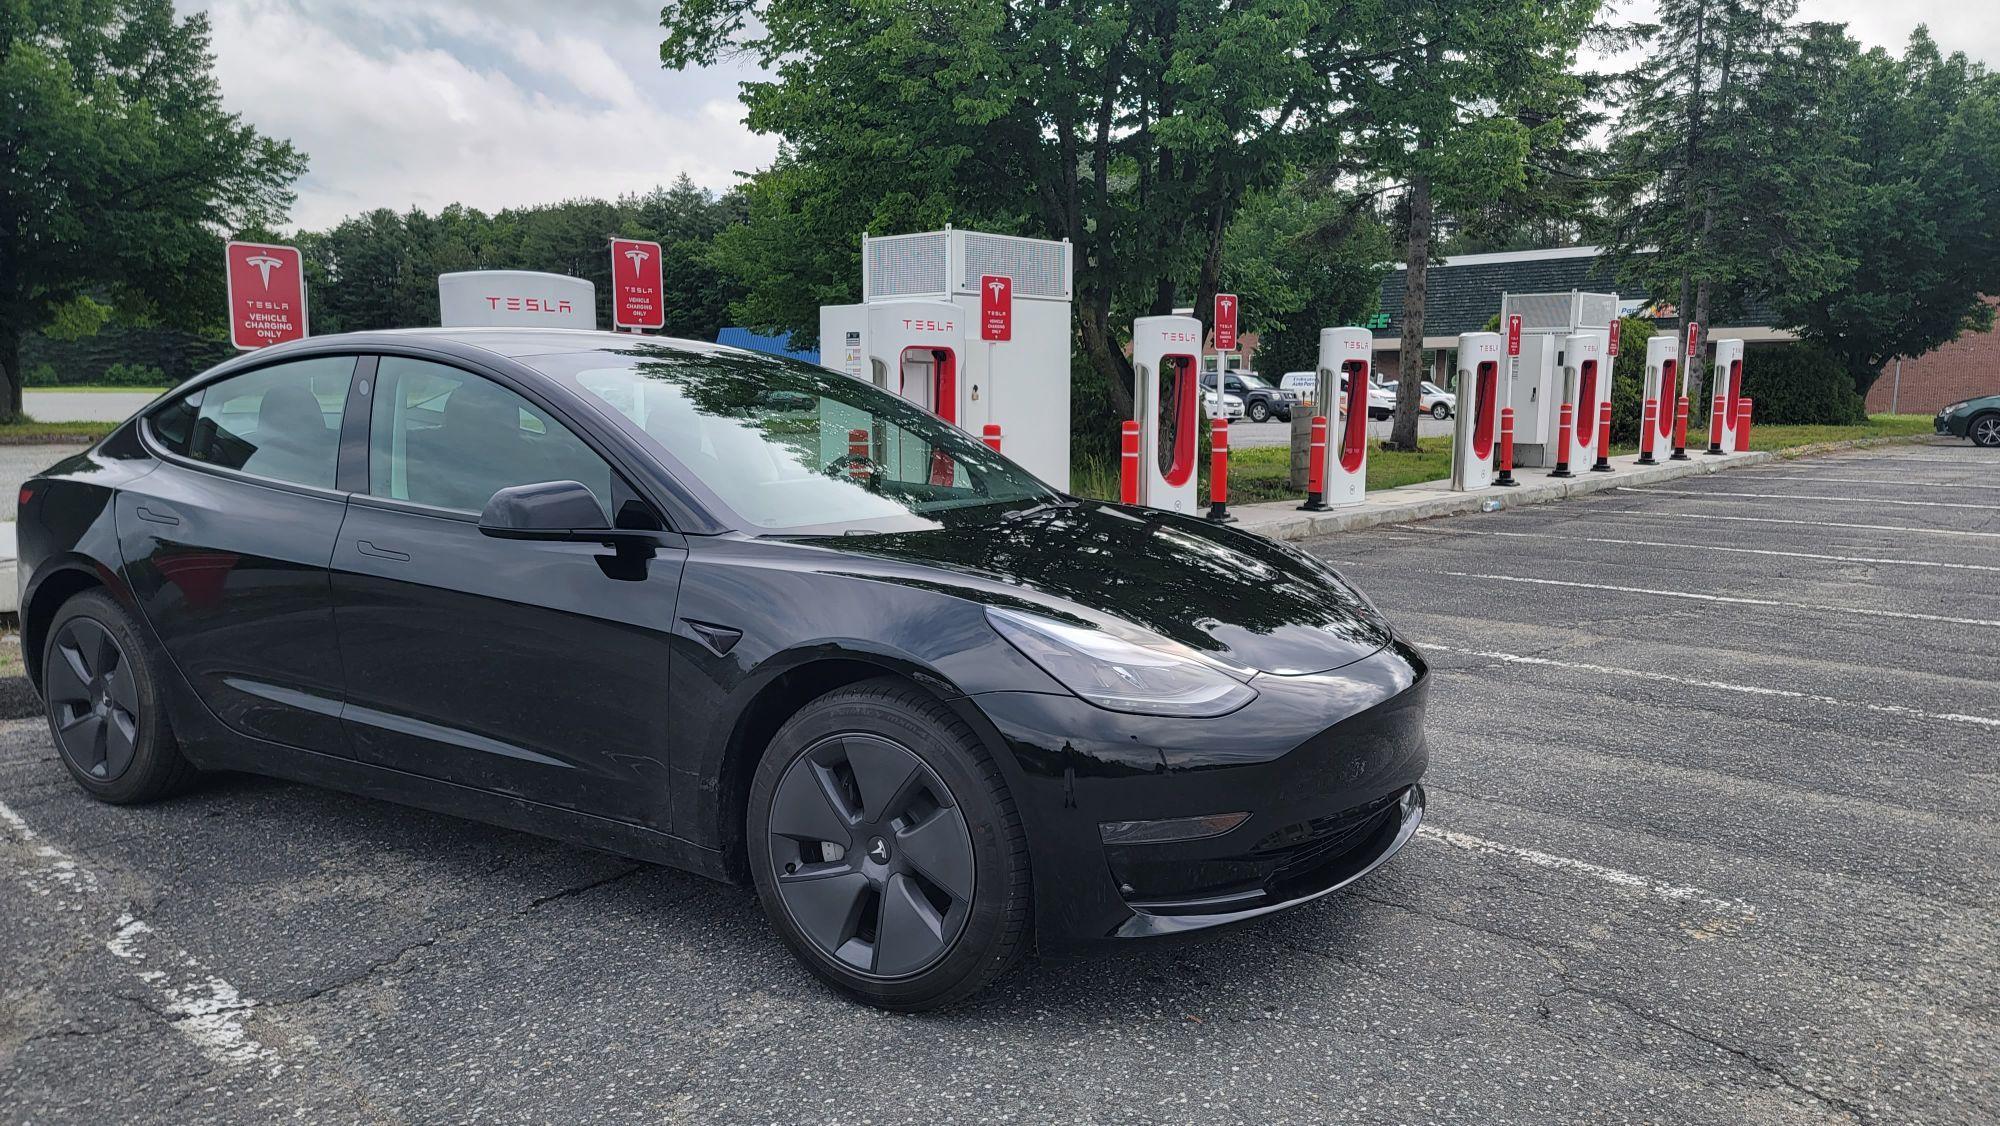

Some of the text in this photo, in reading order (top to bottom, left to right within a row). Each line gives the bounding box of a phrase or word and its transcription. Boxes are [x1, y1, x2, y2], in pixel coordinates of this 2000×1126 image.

[624, 286, 653, 294] TESLA
[246, 300, 289, 310] TESLA
[485, 297, 571, 313] TESLA
[249, 312, 288, 322] VEHICLE
[245, 321, 293, 331] CHARGING
[902, 319, 953, 331] TESLA
[257, 330, 282, 338] ONLY
[1162, 332, 1196, 342] TESLA
[1344, 341, 1369, 350] TESLA
